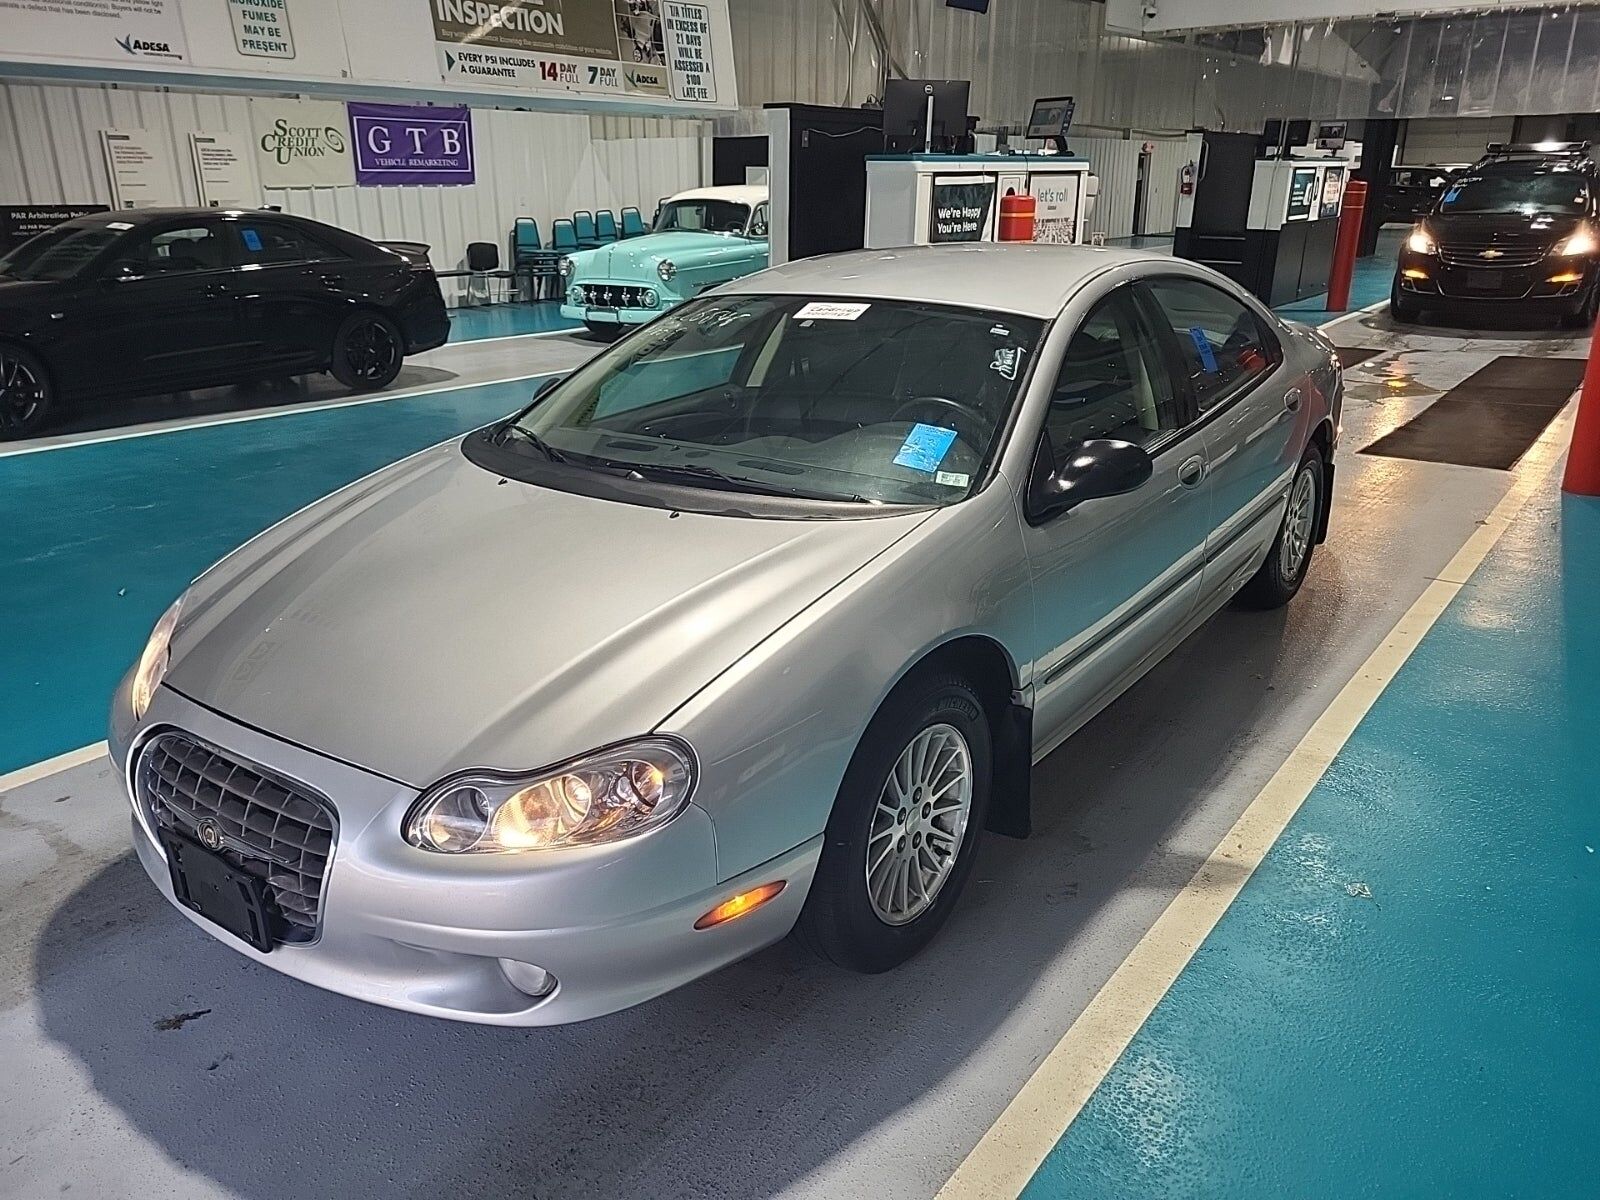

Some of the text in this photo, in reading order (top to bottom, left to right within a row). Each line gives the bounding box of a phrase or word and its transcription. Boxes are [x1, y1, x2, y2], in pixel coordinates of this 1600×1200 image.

[242, 10, 277, 22] FUMES
[437, 0, 564, 36] INSPECTION
[681, 7, 702, 20] TITLES
[243, 24, 281, 37] MAY BE
[667, 19, 707, 34] IN EXCESS OF
[133, 39, 170, 52] ADESA
[242, 39, 287, 52] PRESENT
[676, 33, 702, 46] 21 DAYS
[678, 47, 702, 59] WILL BE
[458, 52, 536, 68] EVERY PSI INCLUDES
[674, 59, 710, 73] ASSESSED A
[460, 64, 516, 78] A GUARANTEE
[539, 61, 558, 81] 14
[560, 63, 578, 74] DAY
[600, 67, 617, 77] DAY
[560, 73, 580, 84] FULL
[587, 66, 599, 85] 7
[600, 77, 618, 87] FULL
[636, 73, 658, 85] ADESA
[686, 73, 701, 86] $100
[682, 87, 708, 99] LATE FEE
[261, 134, 317, 152] CREDIT
[276, 147, 325, 165] UNION
[374, 158, 406, 167] VEHICLE
[409, 158, 459, 168] REMARKETING
[1038, 186, 1068, 202] let's roll
[28, 211, 69, 219] Arbitration
[938, 206, 981, 220] We're Happy
[937, 221, 978, 234] You're Here
